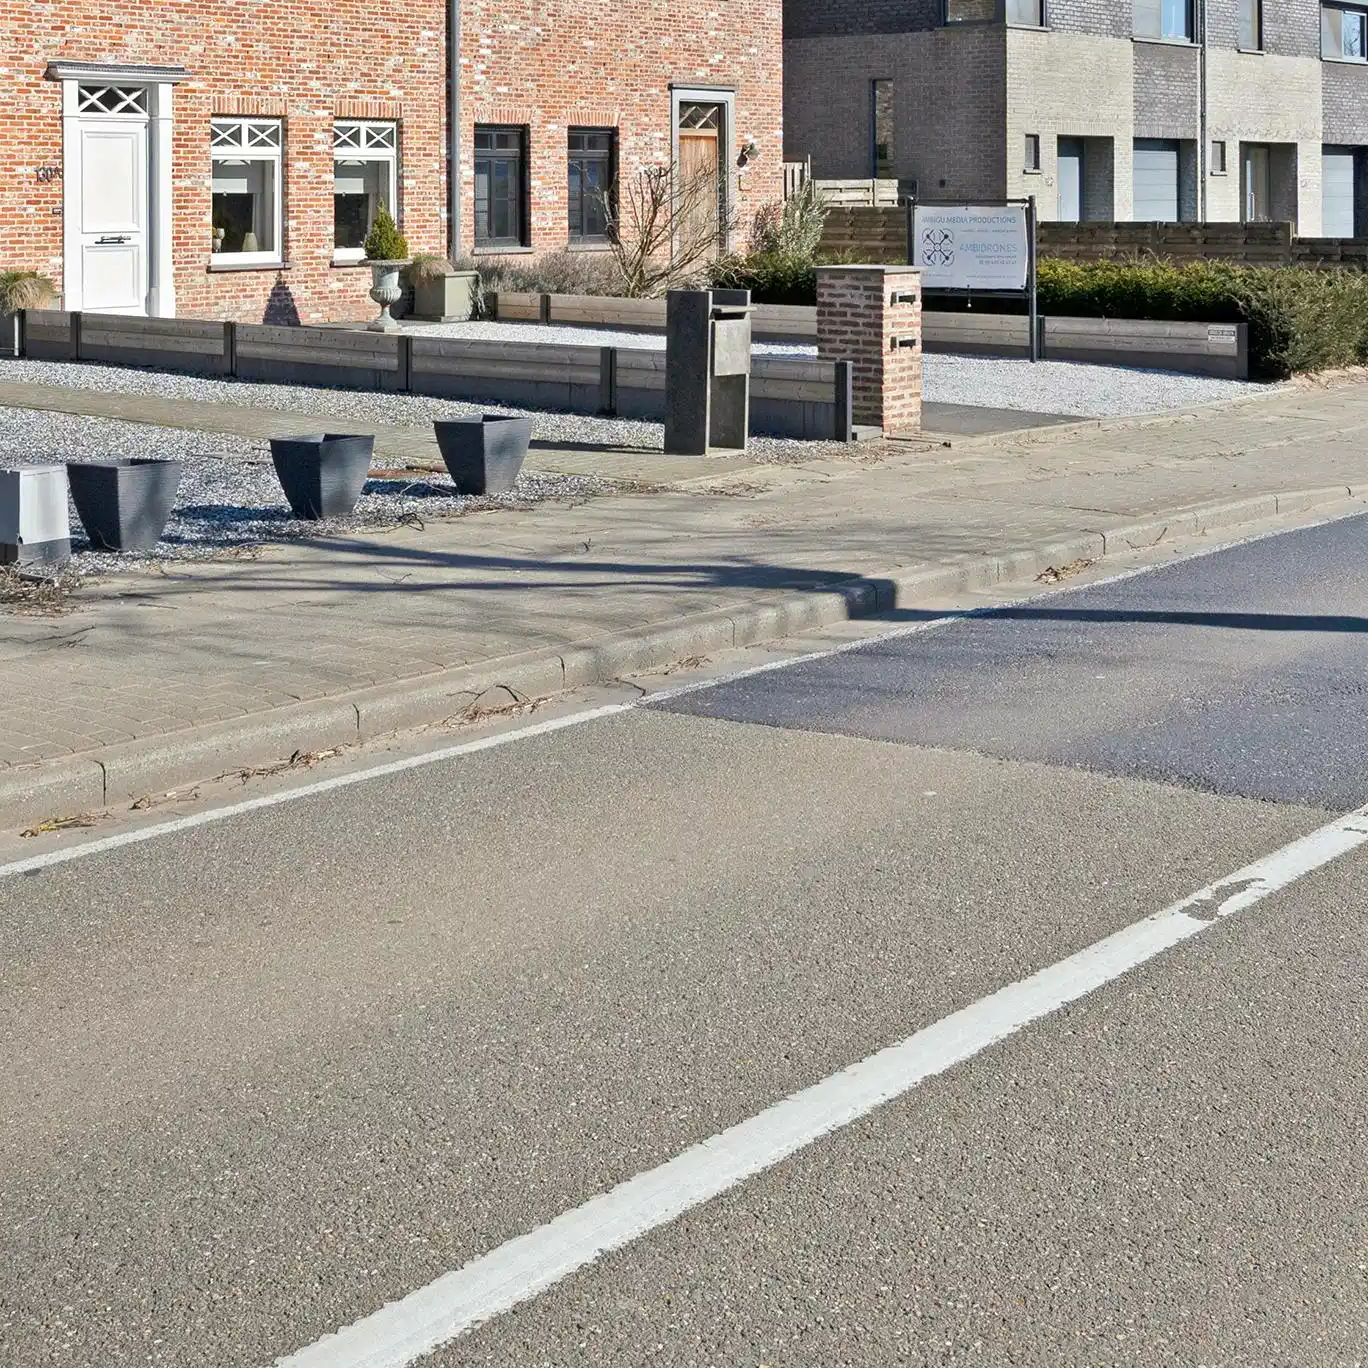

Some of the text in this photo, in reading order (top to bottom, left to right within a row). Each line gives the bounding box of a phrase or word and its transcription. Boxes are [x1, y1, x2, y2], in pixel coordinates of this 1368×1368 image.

[946, 215, 968, 224] MEDIA
[969, 215, 1016, 224] PRODUCTIONS
[960, 243, 1017, 252] AMBIDRONES
